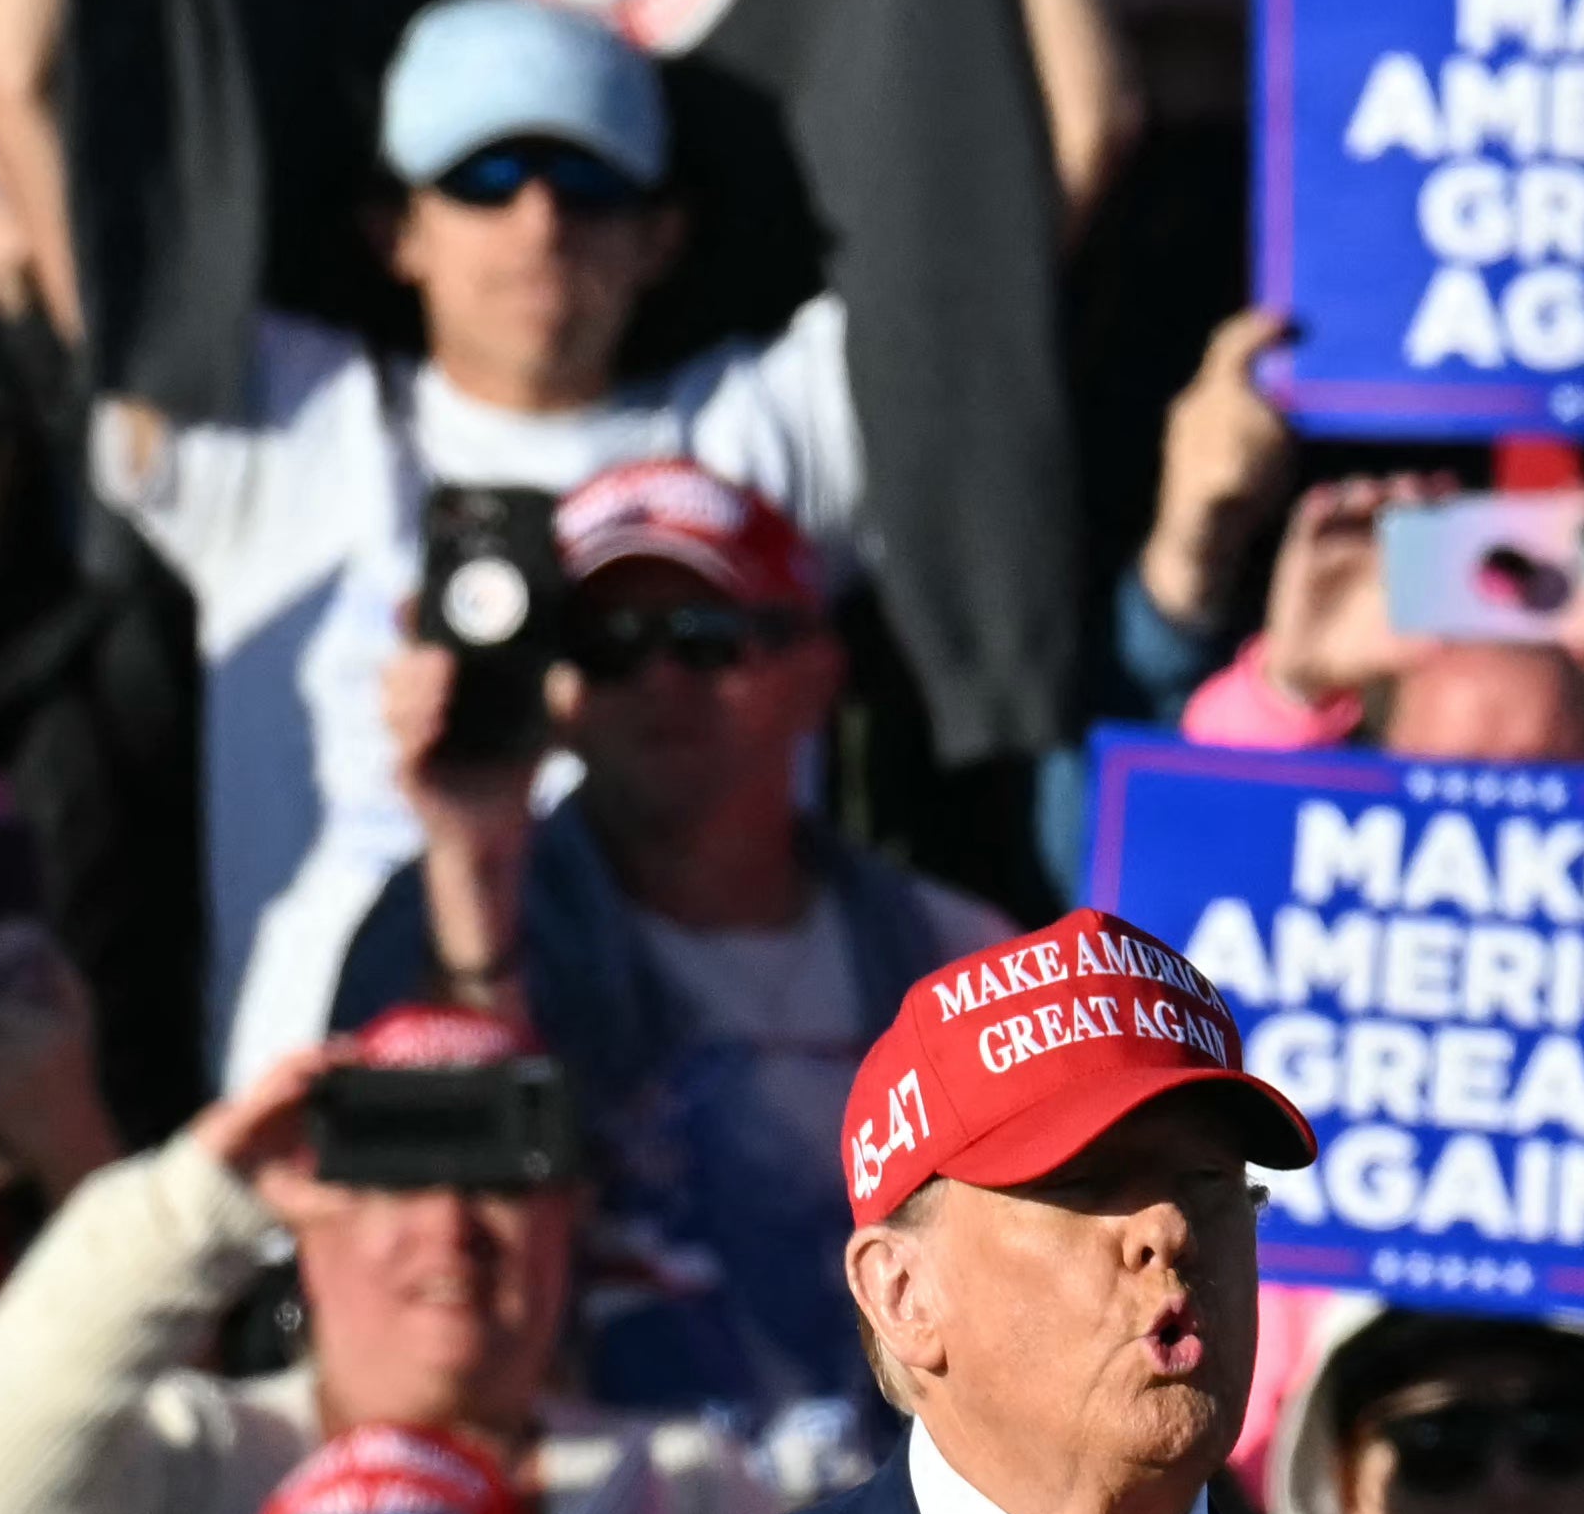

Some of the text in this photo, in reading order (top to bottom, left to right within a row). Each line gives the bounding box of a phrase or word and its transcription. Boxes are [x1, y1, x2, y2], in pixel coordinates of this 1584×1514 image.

[932, 930, 1231, 1023] MAKE AMERICA
[978, 996, 1228, 1075] GREAT AGAIN
[850, 1067, 931, 1201] 45-47
